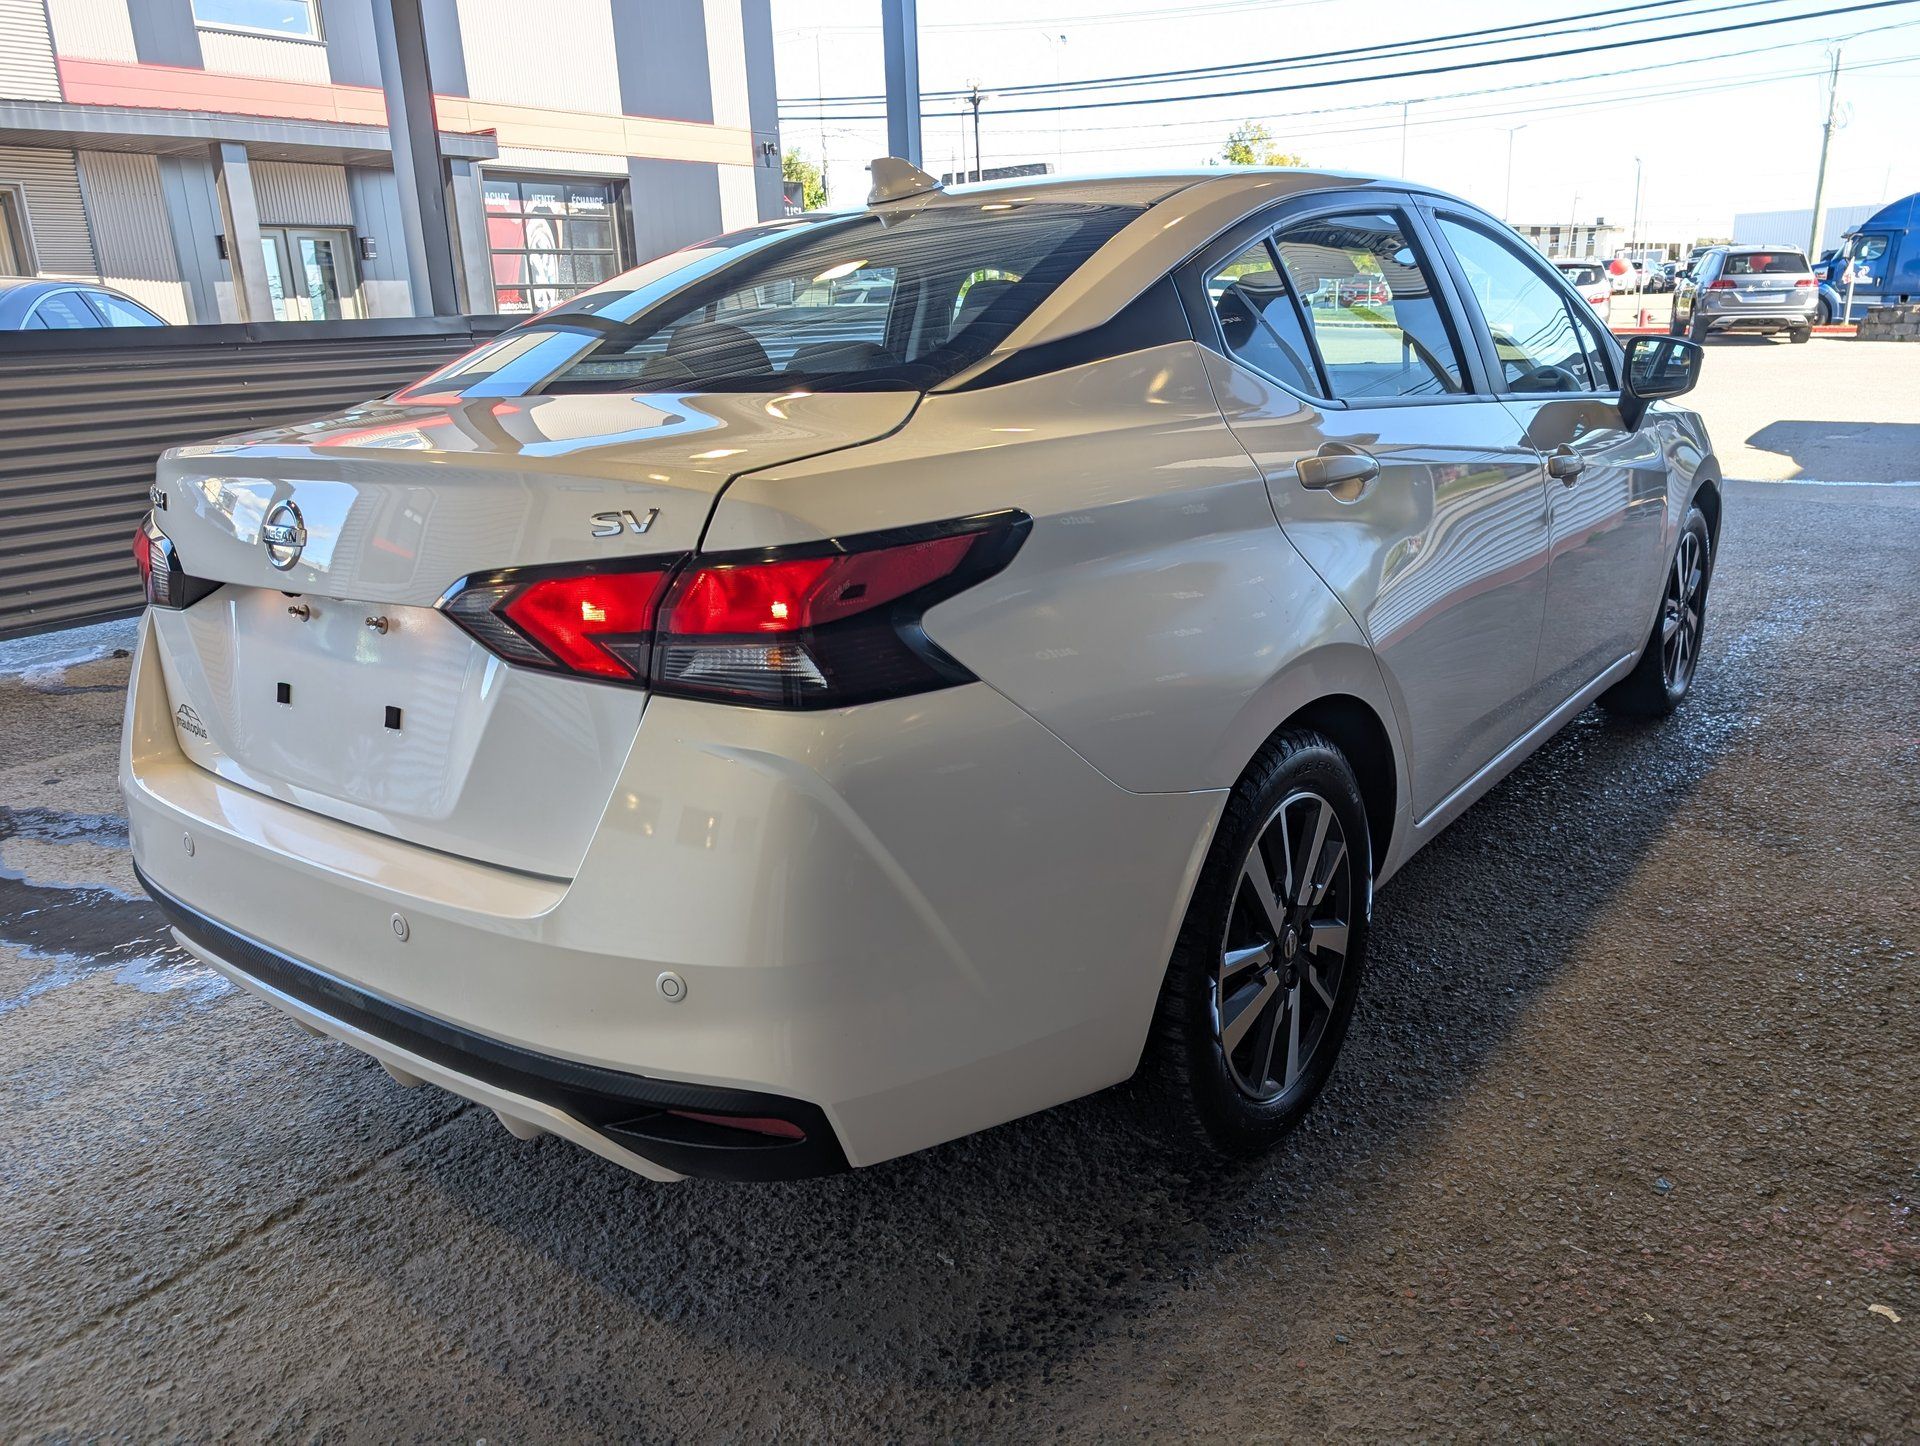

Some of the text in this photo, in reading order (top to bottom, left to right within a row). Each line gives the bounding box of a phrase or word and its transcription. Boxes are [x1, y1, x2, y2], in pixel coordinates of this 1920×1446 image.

[485, 191, 509, 205] ACHAT
[532, 194, 556, 207] VENTE
[589, 508, 660, 537] SV
[264, 527, 297, 543] NISSAN
